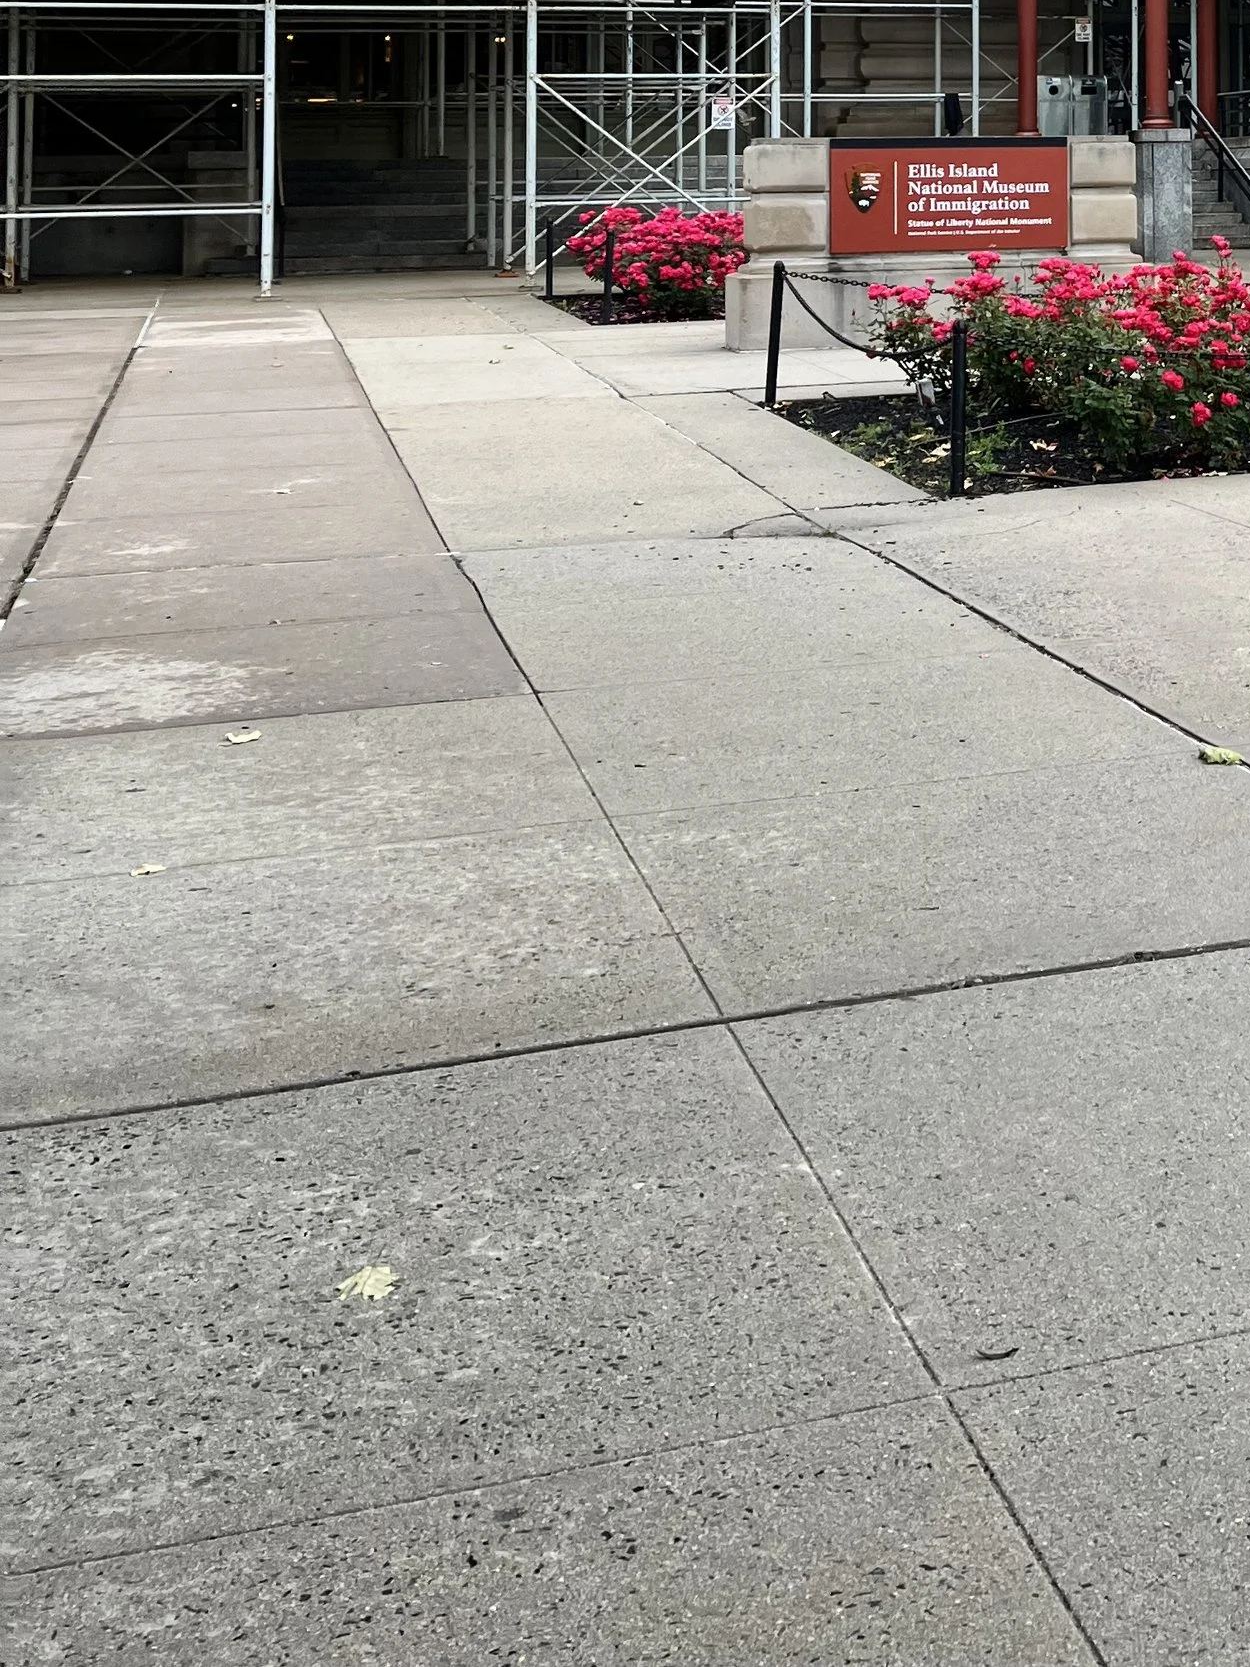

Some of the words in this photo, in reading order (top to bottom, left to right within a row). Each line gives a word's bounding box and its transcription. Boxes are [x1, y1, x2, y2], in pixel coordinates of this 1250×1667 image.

[908, 164, 945, 178] Ellis
[948, 163, 999, 178] Island
[908, 180, 978, 195] National
[982, 180, 1050, 194] Museum
[908, 197, 926, 212] of
[930, 196, 1030, 214] Immigration
[907, 219, 934, 228] Statue
[935, 219, 945, 227] of
[946, 218, 973, 229] Liberty
[975, 218, 1009, 226] National
[1010, 217, 1052, 225] Monument
